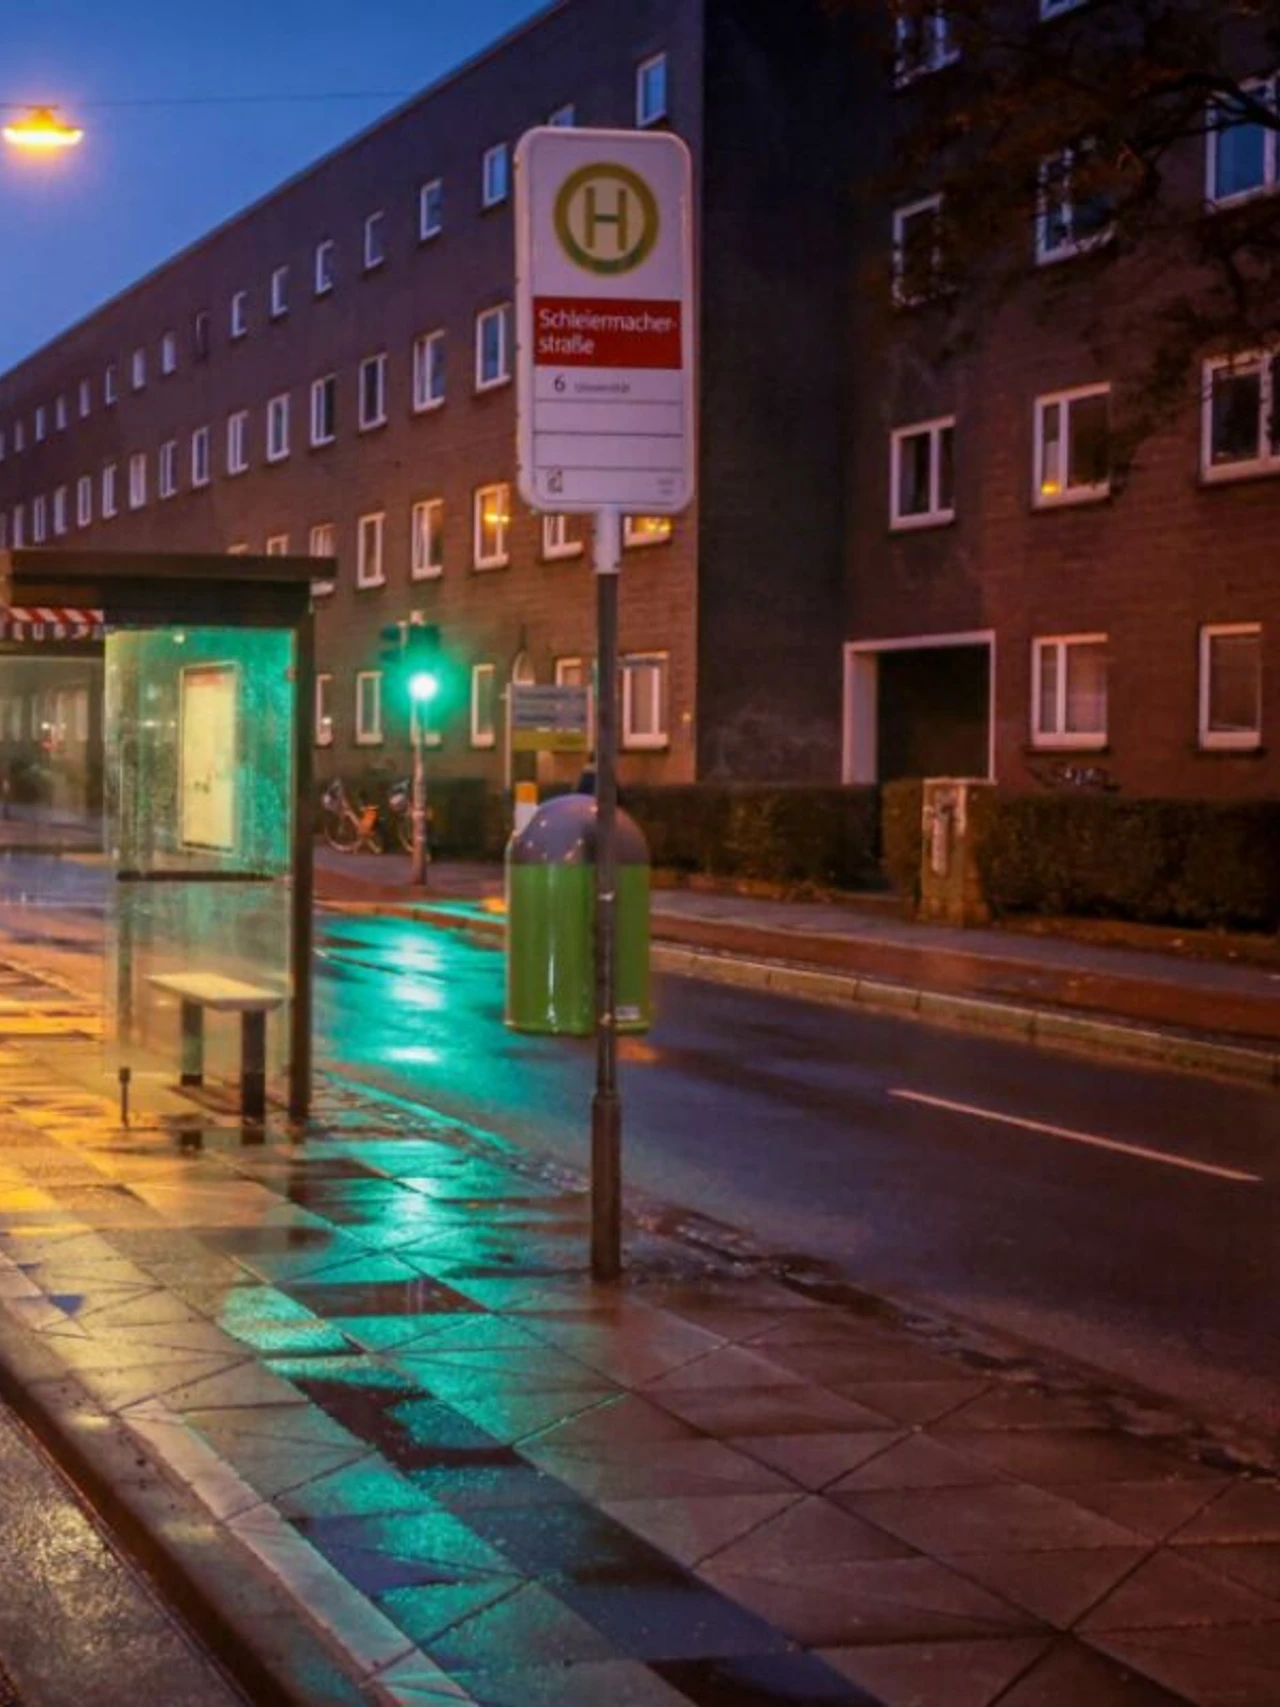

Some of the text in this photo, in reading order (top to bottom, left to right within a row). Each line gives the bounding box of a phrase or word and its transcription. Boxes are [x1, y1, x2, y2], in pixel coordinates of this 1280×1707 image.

[584, 186, 627, 250] H
[539, 334, 595, 355] straße
[554, 374, 567, 393] 6
